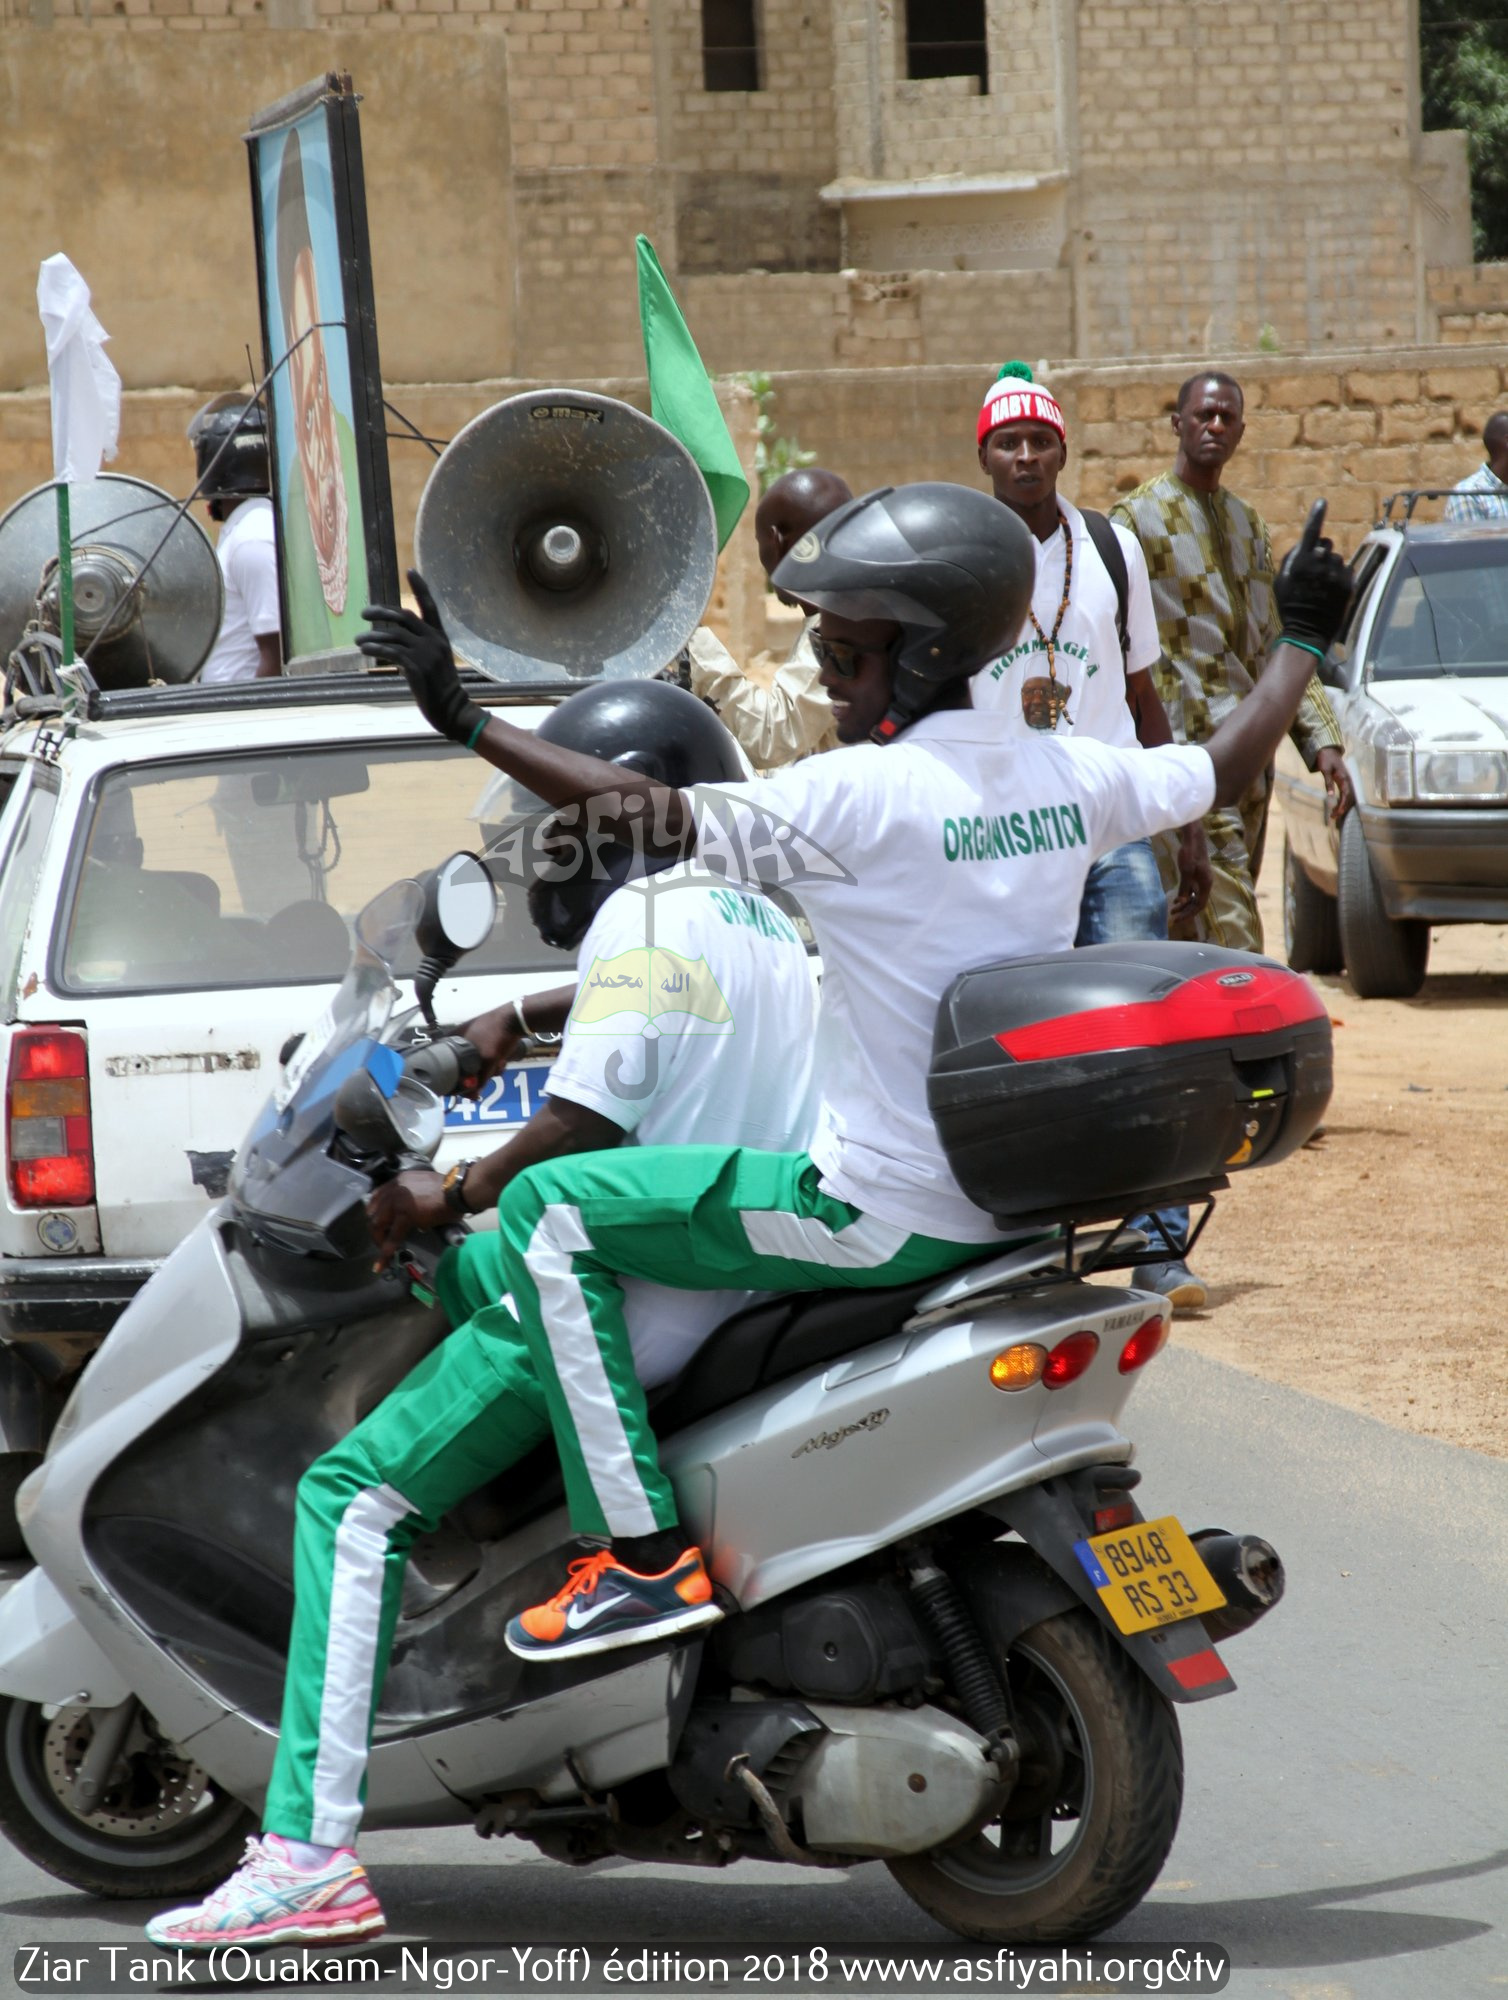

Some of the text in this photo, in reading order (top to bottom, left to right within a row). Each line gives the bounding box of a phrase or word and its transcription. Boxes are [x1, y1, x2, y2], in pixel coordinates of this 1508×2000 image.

[990, 393, 1032, 426] NABY
[1104, 1531, 1173, 1578] 8948
[1122, 1580, 1165, 1619] RS
[1157, 1570, 1198, 1608] 33
